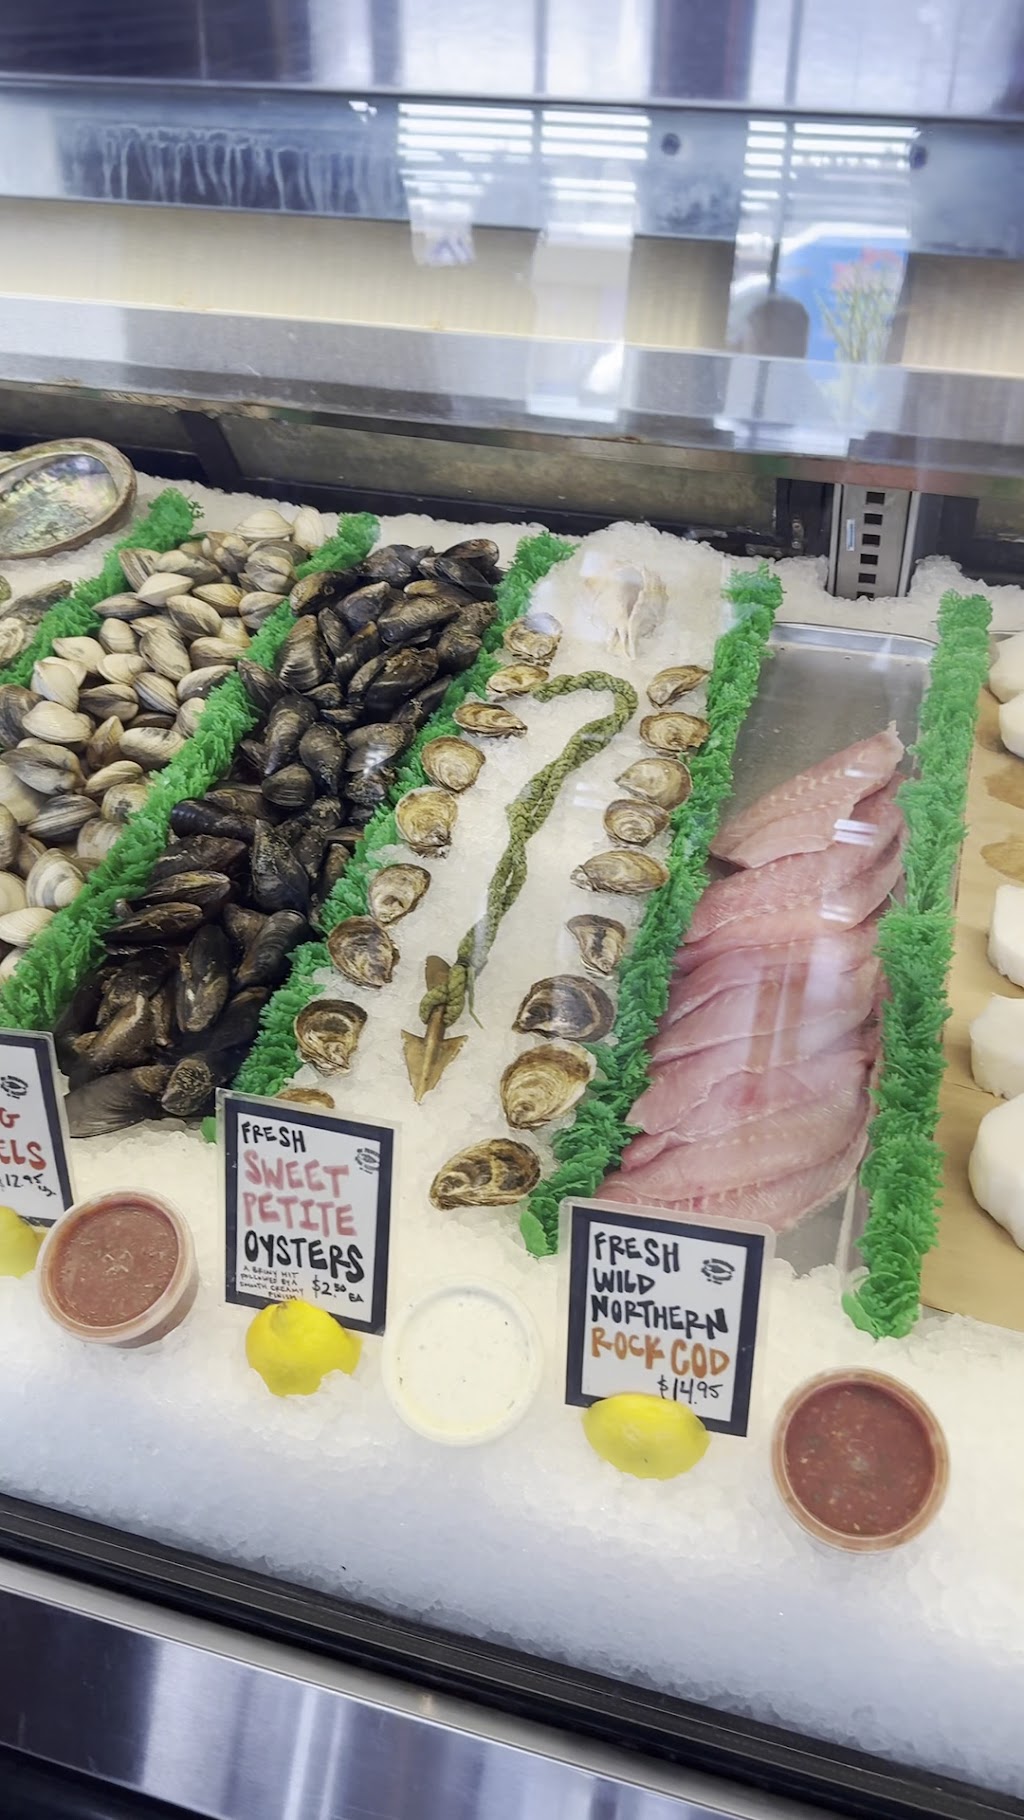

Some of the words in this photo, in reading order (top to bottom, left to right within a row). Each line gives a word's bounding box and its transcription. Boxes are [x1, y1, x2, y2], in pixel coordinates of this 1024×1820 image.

[241, 1121, 307, 1153] FRESH
[243, 1149, 350, 1198] SWEET
[242, 1191, 358, 1238] PETITE
[244, 1230, 365, 1284] OYSTERS
[593, 1231, 680, 1273] FRESH
[348, 1293, 364, 1303] EA
[592, 1267, 656, 1295] WILD
[590, 1294, 729, 1340] NORTHERN
[591, 1326, 665, 1370] ROCK
[670, 1338, 730, 1379] COD
[657, 1374, 724, 1405] $14.95
